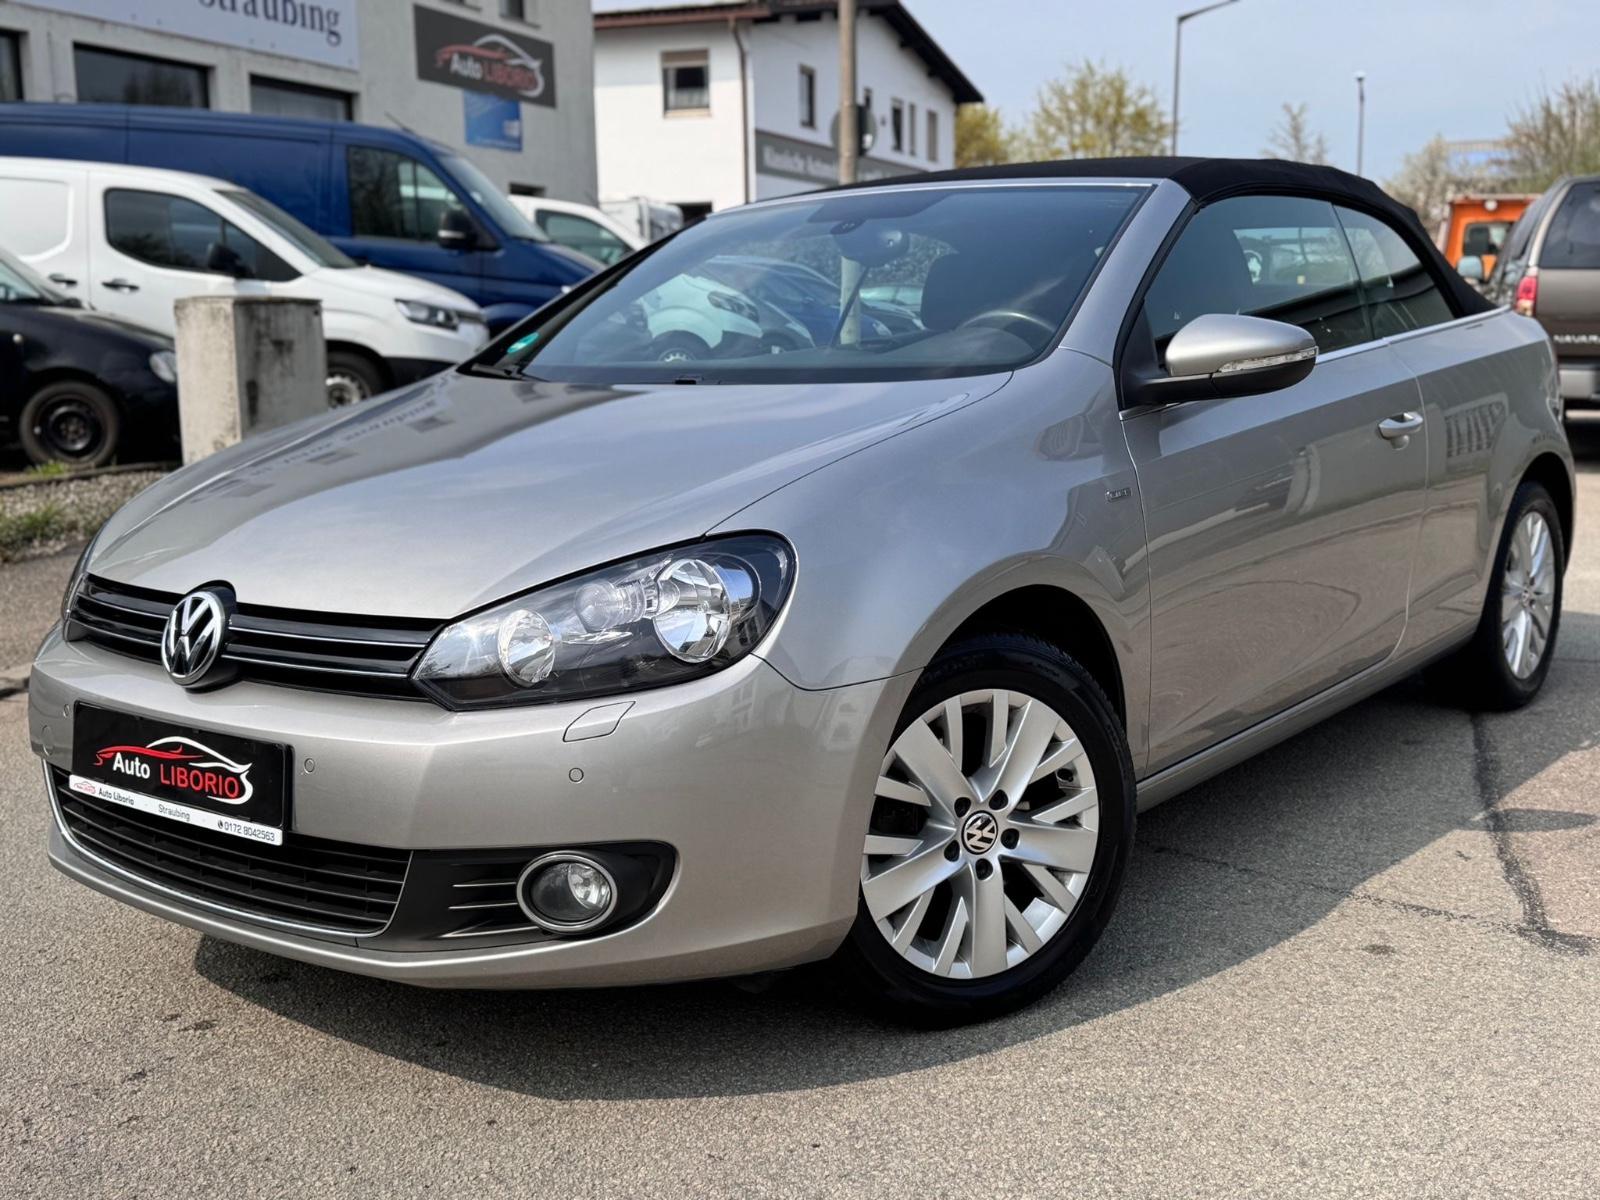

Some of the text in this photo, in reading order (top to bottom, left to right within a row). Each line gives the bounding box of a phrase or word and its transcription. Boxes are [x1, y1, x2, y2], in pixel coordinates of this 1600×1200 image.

[199, 0, 342, 47] aubing
[450, 53, 483, 80] Auto
[112, 752, 240, 798] Auto LIBORIO
[98, 788, 112, 799] Auto
[113, 791, 135, 806] Liborio
[158, 803, 190, 822] Straubing
[224, 821, 242, 834] 0172
[243, 826, 275, 842] 8042563
